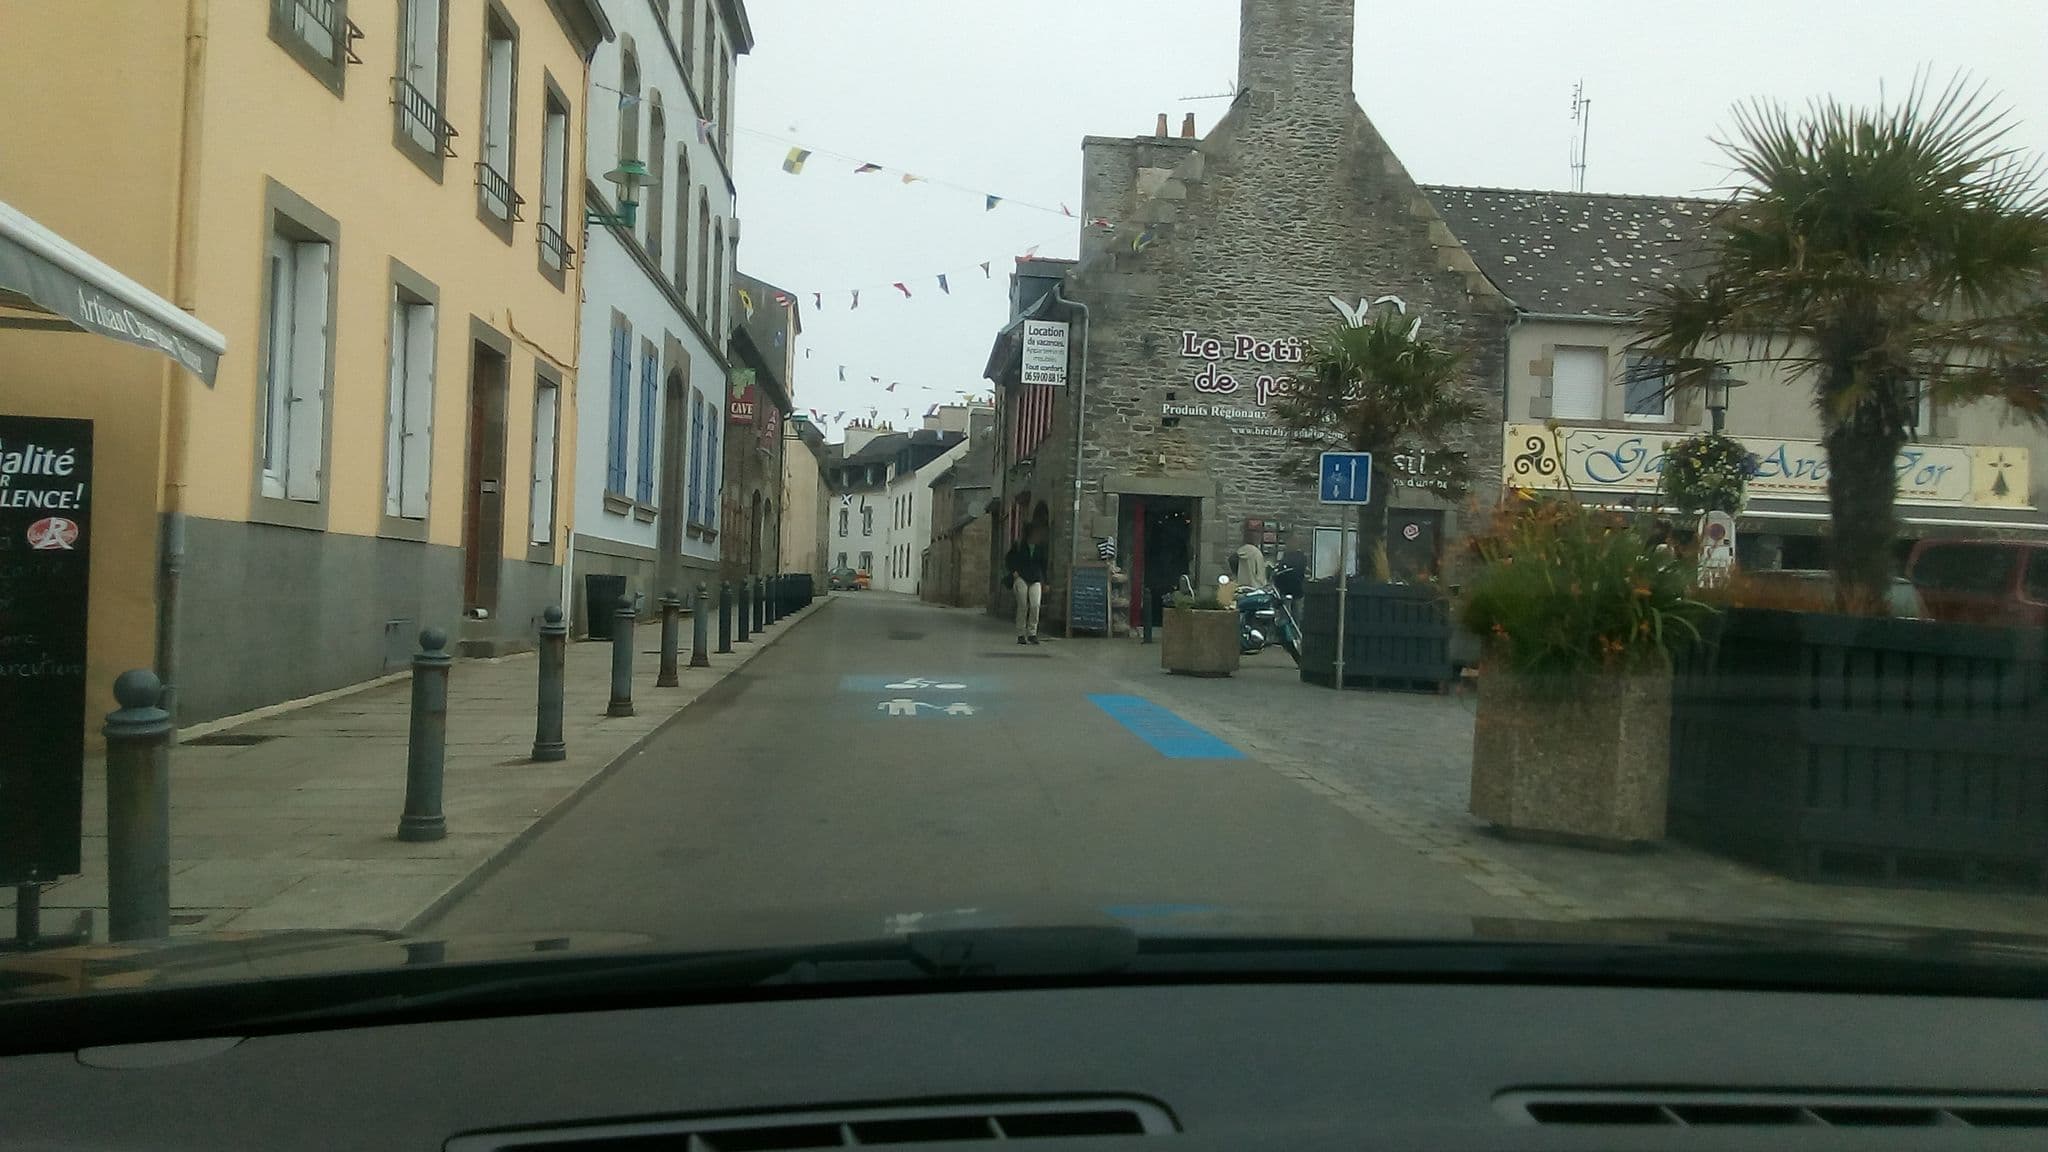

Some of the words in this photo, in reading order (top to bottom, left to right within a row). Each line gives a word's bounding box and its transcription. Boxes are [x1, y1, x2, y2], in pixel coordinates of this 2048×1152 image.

[1028, 325, 1065, 337] Location
[1182, 331, 1221, 360] Le
[1194, 362, 1238, 394] de
[731, 402, 753, 414] CAVE
[1162, 403, 1208, 416] Produits
[1211, 406, 1268, 420] Régionaux
